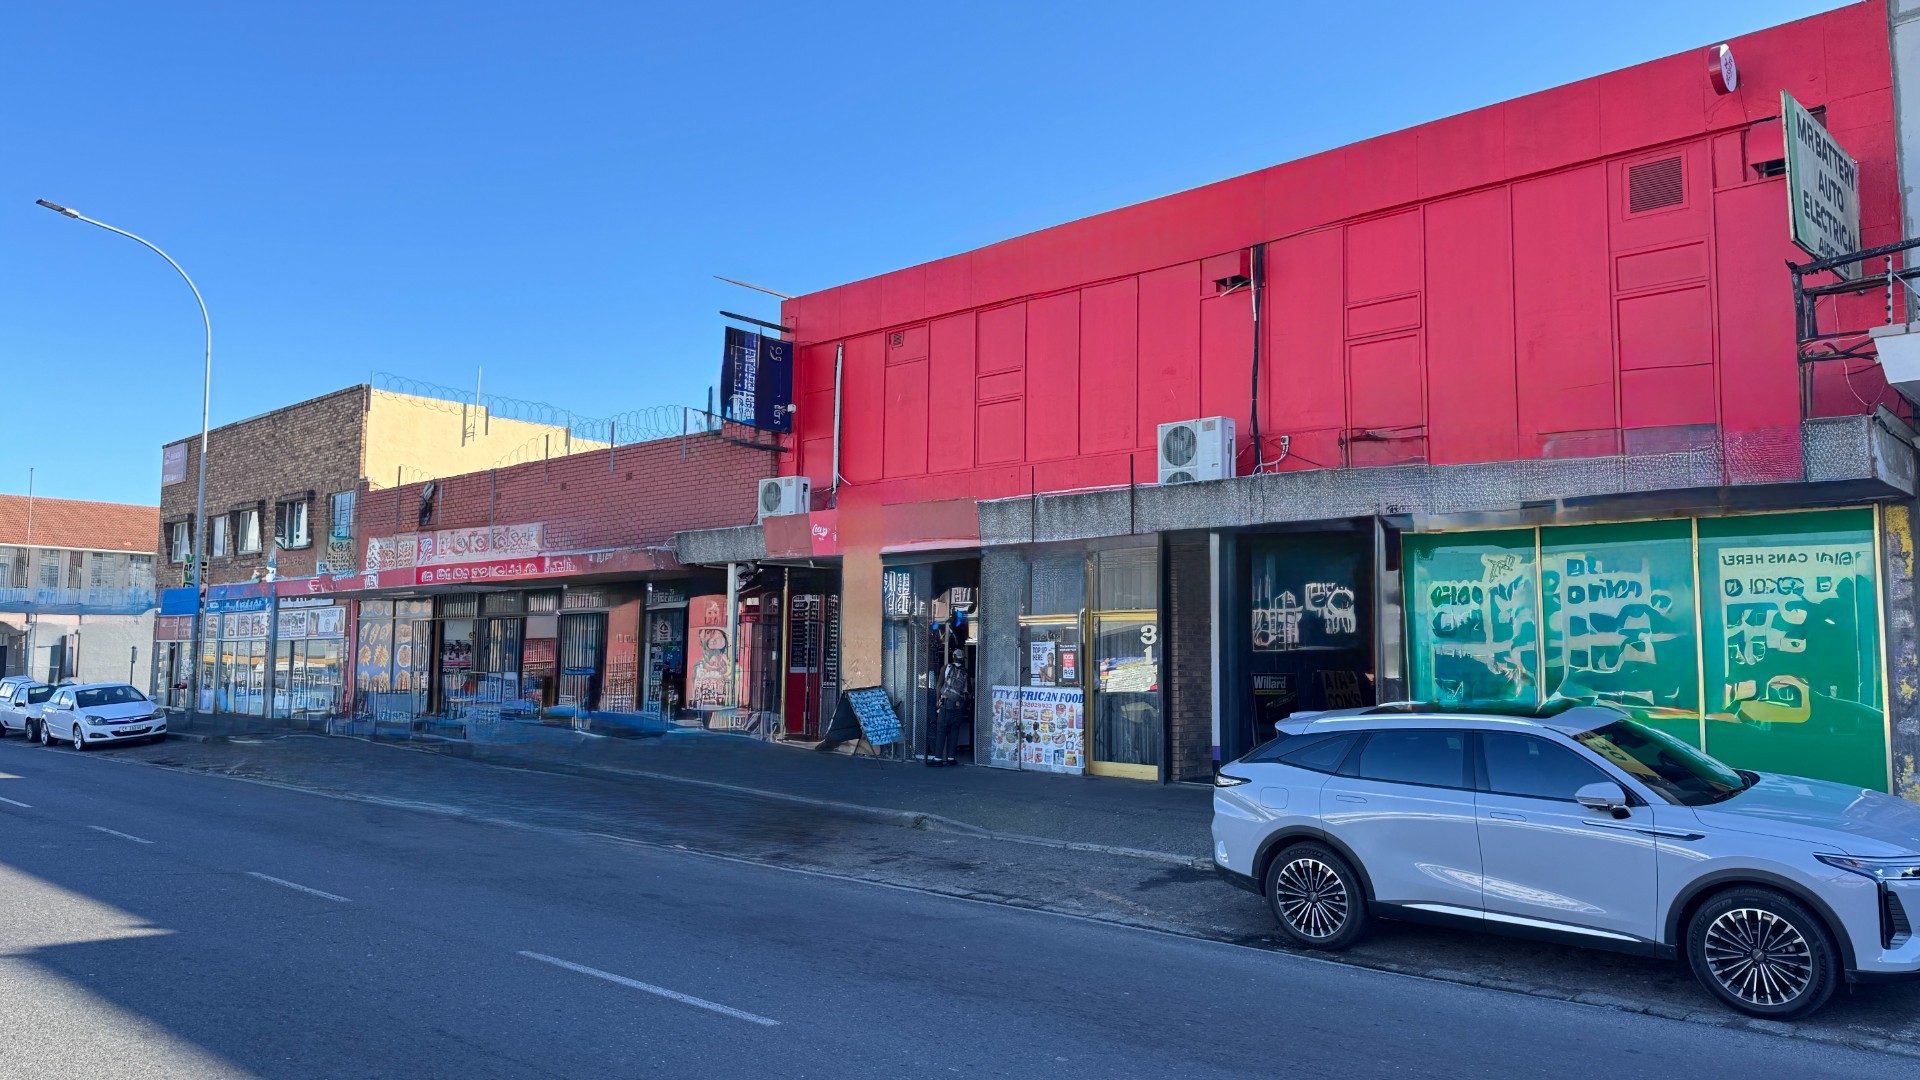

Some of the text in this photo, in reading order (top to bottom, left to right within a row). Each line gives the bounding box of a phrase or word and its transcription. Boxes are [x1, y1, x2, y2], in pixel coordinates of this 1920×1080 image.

[1796, 112, 1855, 192] MR BATTERY
[1819, 169, 1844, 212] AUTO
[1253, 675, 1286, 689] Willard
[1013, 691, 1058, 702] AFRICAN
